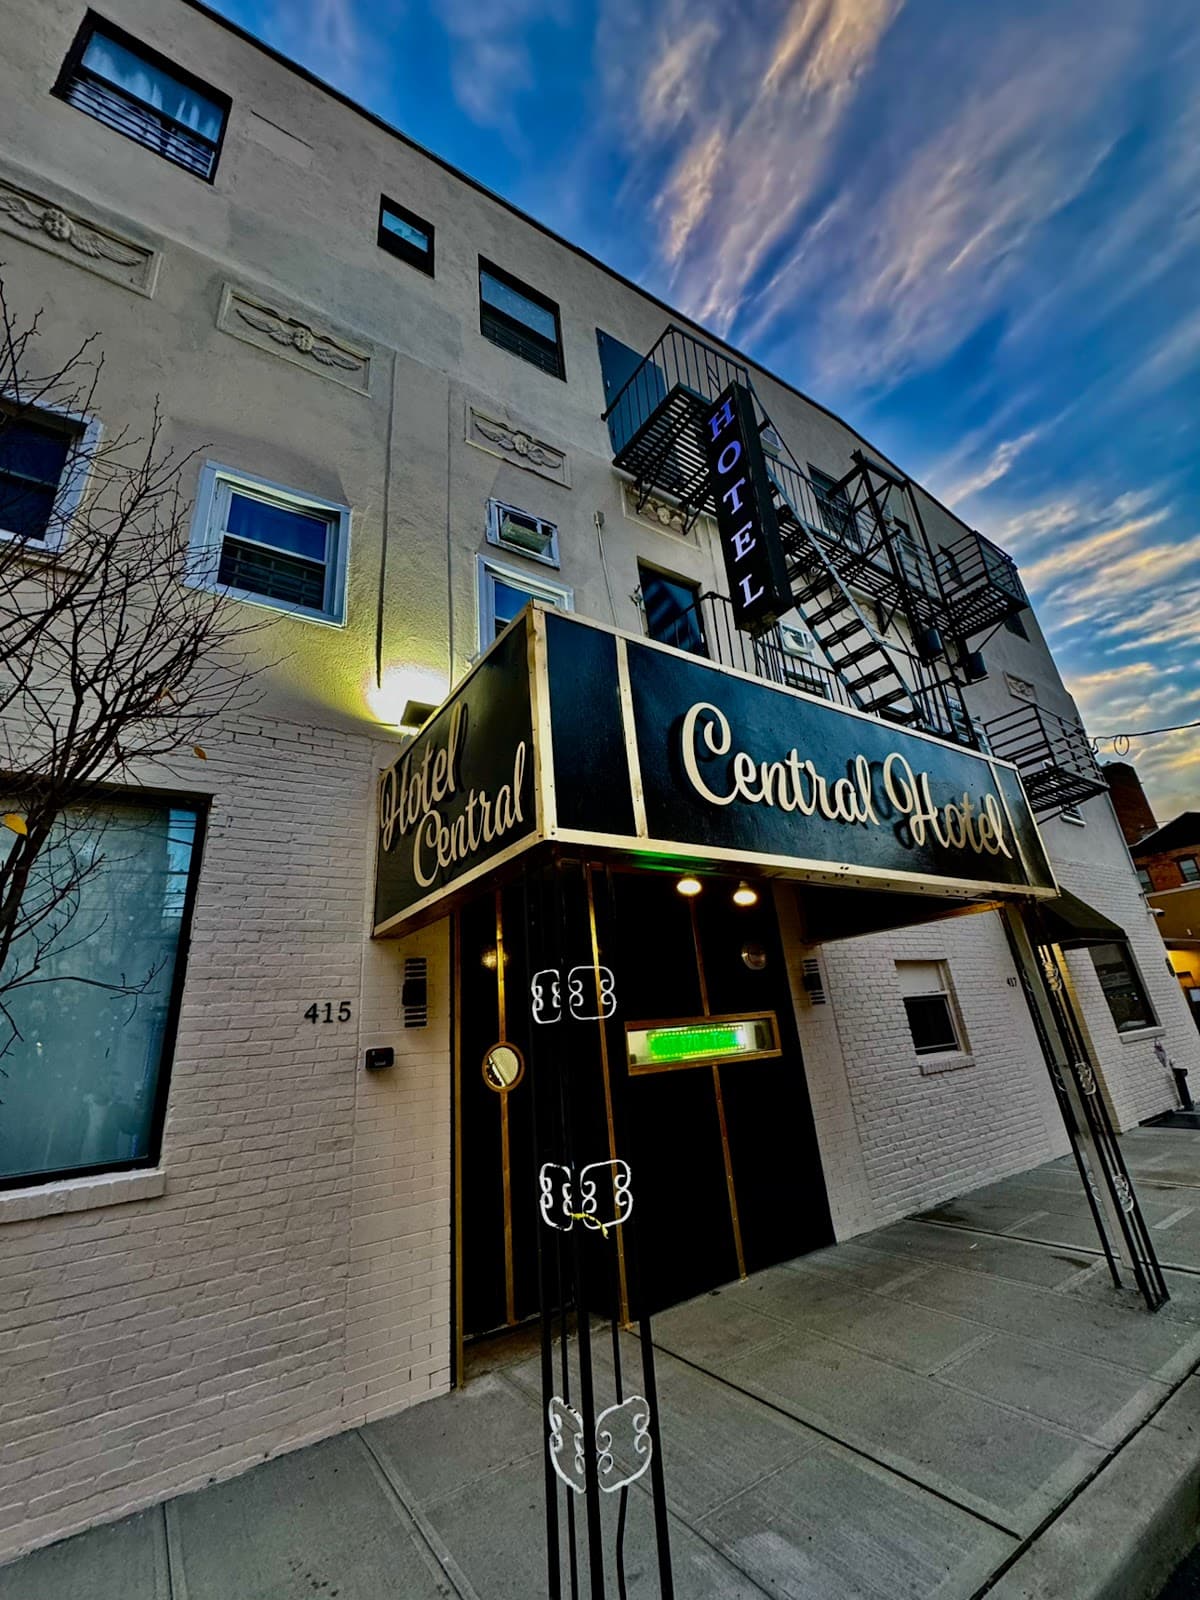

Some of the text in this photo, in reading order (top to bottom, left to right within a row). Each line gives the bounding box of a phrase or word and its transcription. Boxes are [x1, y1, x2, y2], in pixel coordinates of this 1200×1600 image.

[708, 397, 764, 608] HOTEL
[380, 700, 462, 851] Hotel
[413, 741, 527, 888] Central
[681, 702, 1013, 859] Central Hotel
[303, 1001, 351, 1024] 415
